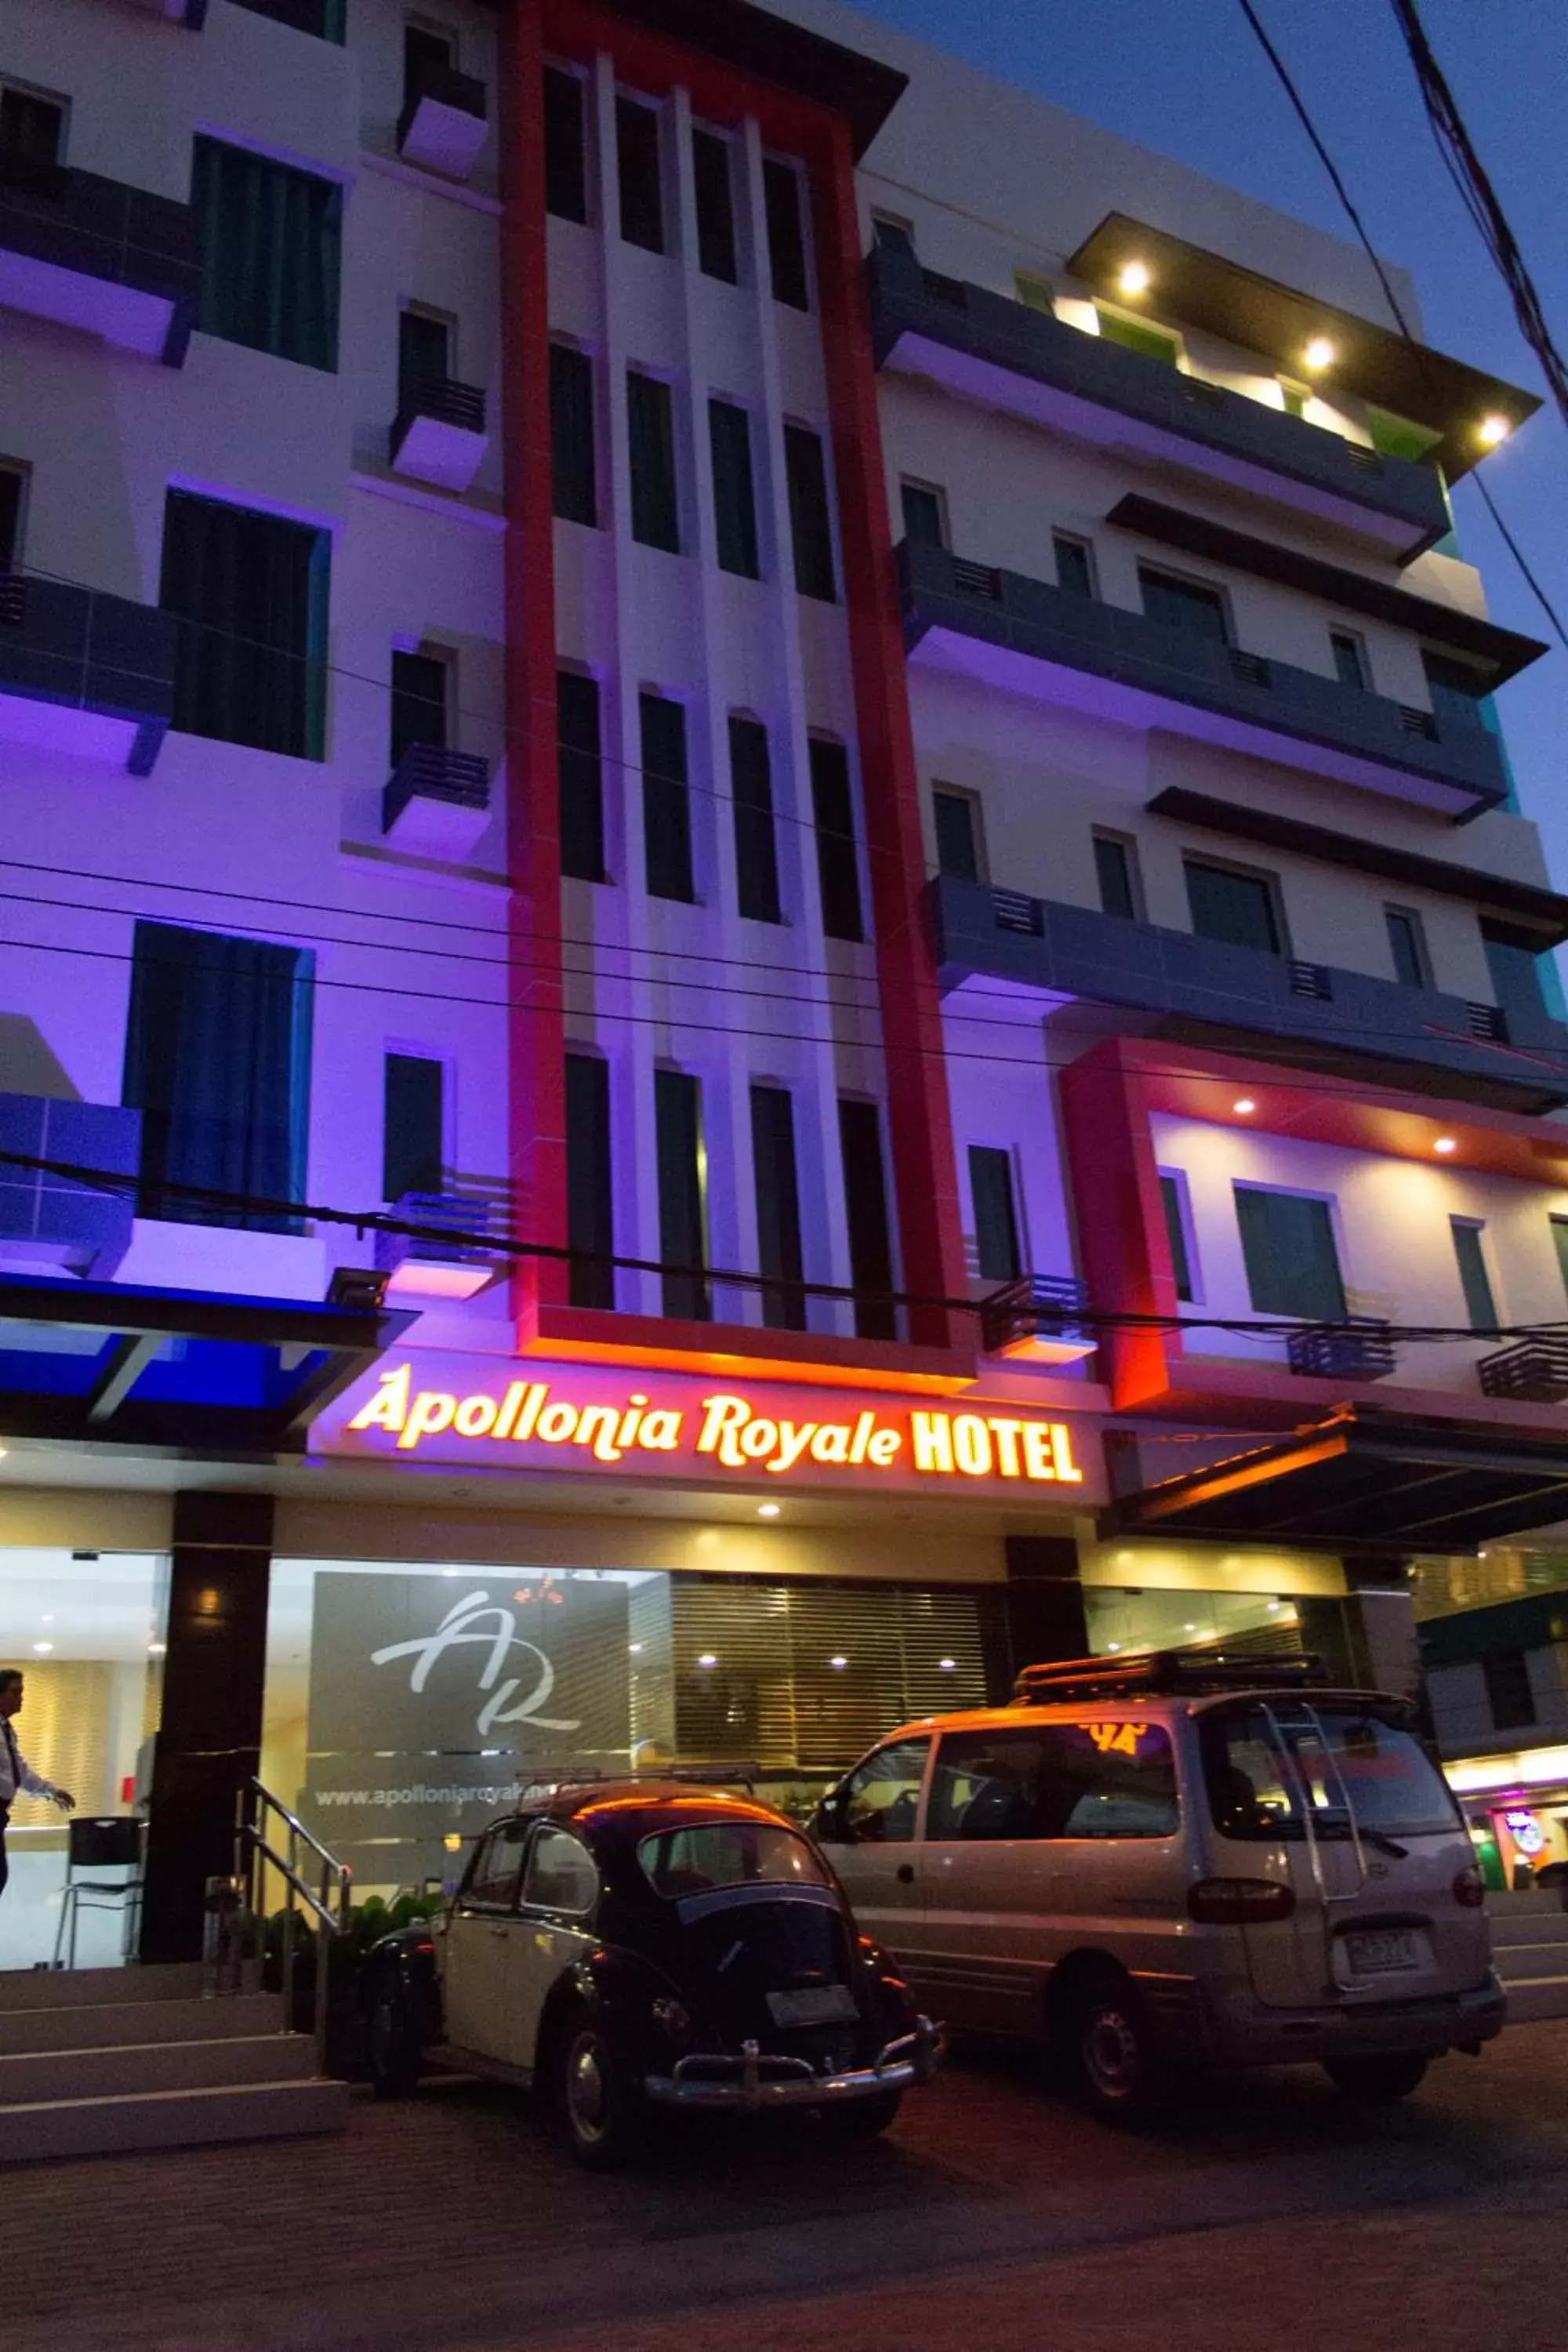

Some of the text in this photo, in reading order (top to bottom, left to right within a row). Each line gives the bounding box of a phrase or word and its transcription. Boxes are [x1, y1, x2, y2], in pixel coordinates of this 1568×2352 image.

[350, 1363, 1082, 1482] Apollonia Royale HOTEL
